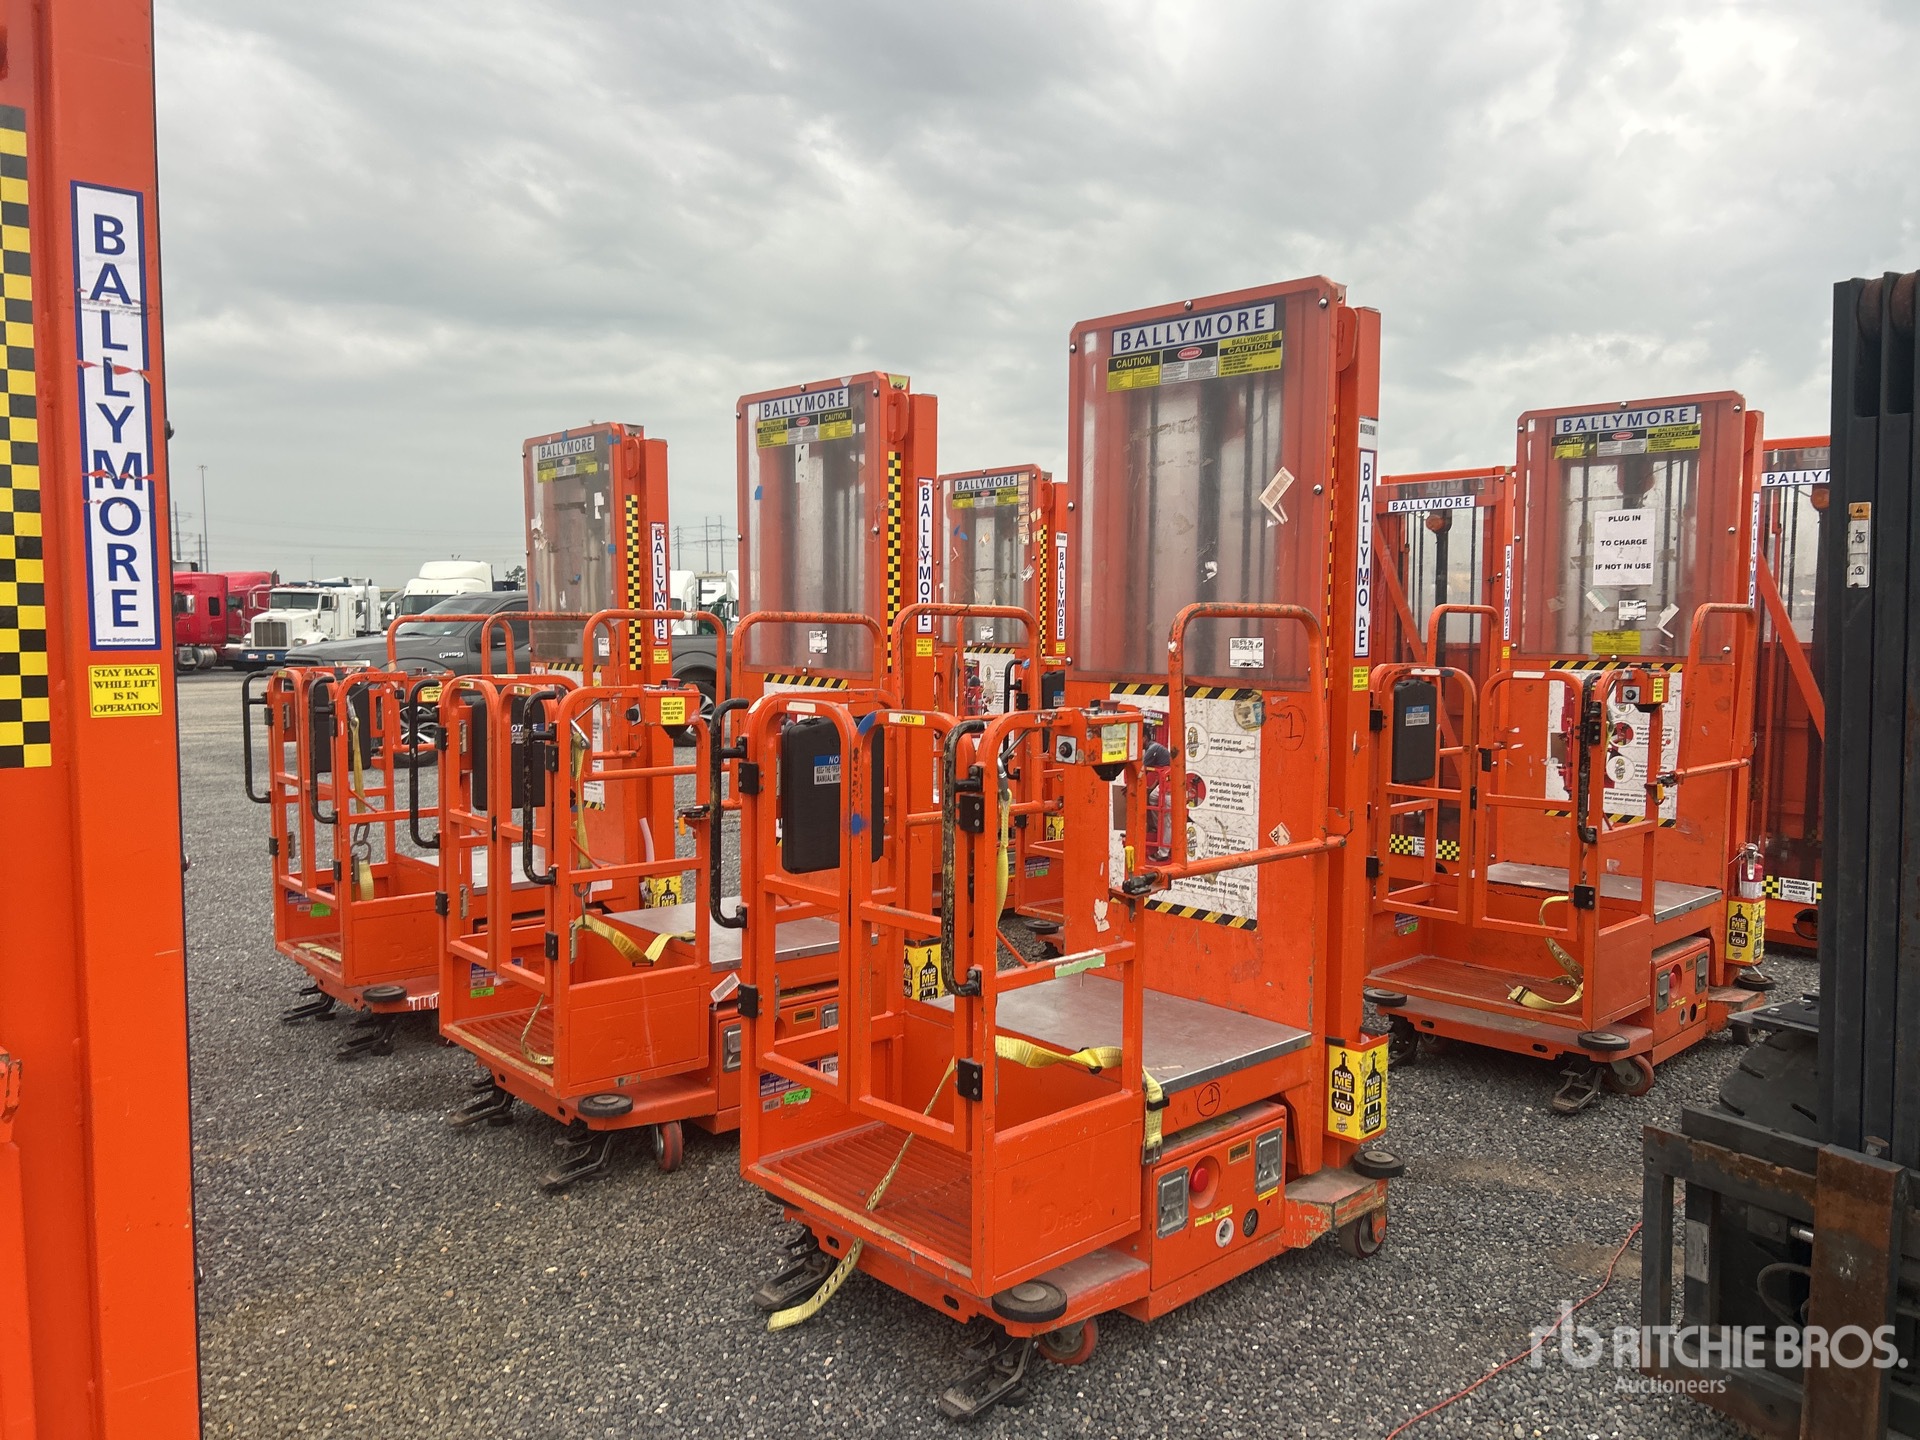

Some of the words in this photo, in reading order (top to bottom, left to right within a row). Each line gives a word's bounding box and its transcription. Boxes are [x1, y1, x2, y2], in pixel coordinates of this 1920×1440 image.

[1120, 308, 1266, 351] BALLYMORE
[1231, 334, 1269, 345] BALLYMORE
[1227, 342, 1273, 354] CAUTION
[1115, 355, 1152, 369] CAUTION
[764, 391, 844, 418] BALLYMORE
[89, 213, 144, 627] BALLYMORE
[824, 412, 847, 422] CAUTION
[1562, 408, 1689, 433] BALLYMORE
[541, 438, 592, 459] BALLYMORE
[957, 476, 1015, 491] BALLYMORE
[1391, 497, 1471, 511] BALLYMORE
[94, 668, 121, 678] STAY
[124, 668, 156, 677] BACK
[94, 680, 131, 688] WHILE
[134, 680, 157, 688] LIFT
[113, 692, 123, 700] IS
[127, 692, 139, 700] IN
[94, 703, 159, 713] OPERATION
[1731, 921, 1746, 929] ME
[1731, 937, 1746, 945] YOU
[921, 967, 936, 976] PLUG
[922, 973, 936, 984] ME
[1334, 1070, 1352, 1079] PLUG
[1334, 1076, 1352, 1089] ME
[1366, 1083, 1380, 1098] ME
[1334, 1100, 1352, 1112] YOU
[1365, 1114, 1380, 1127] YOU
